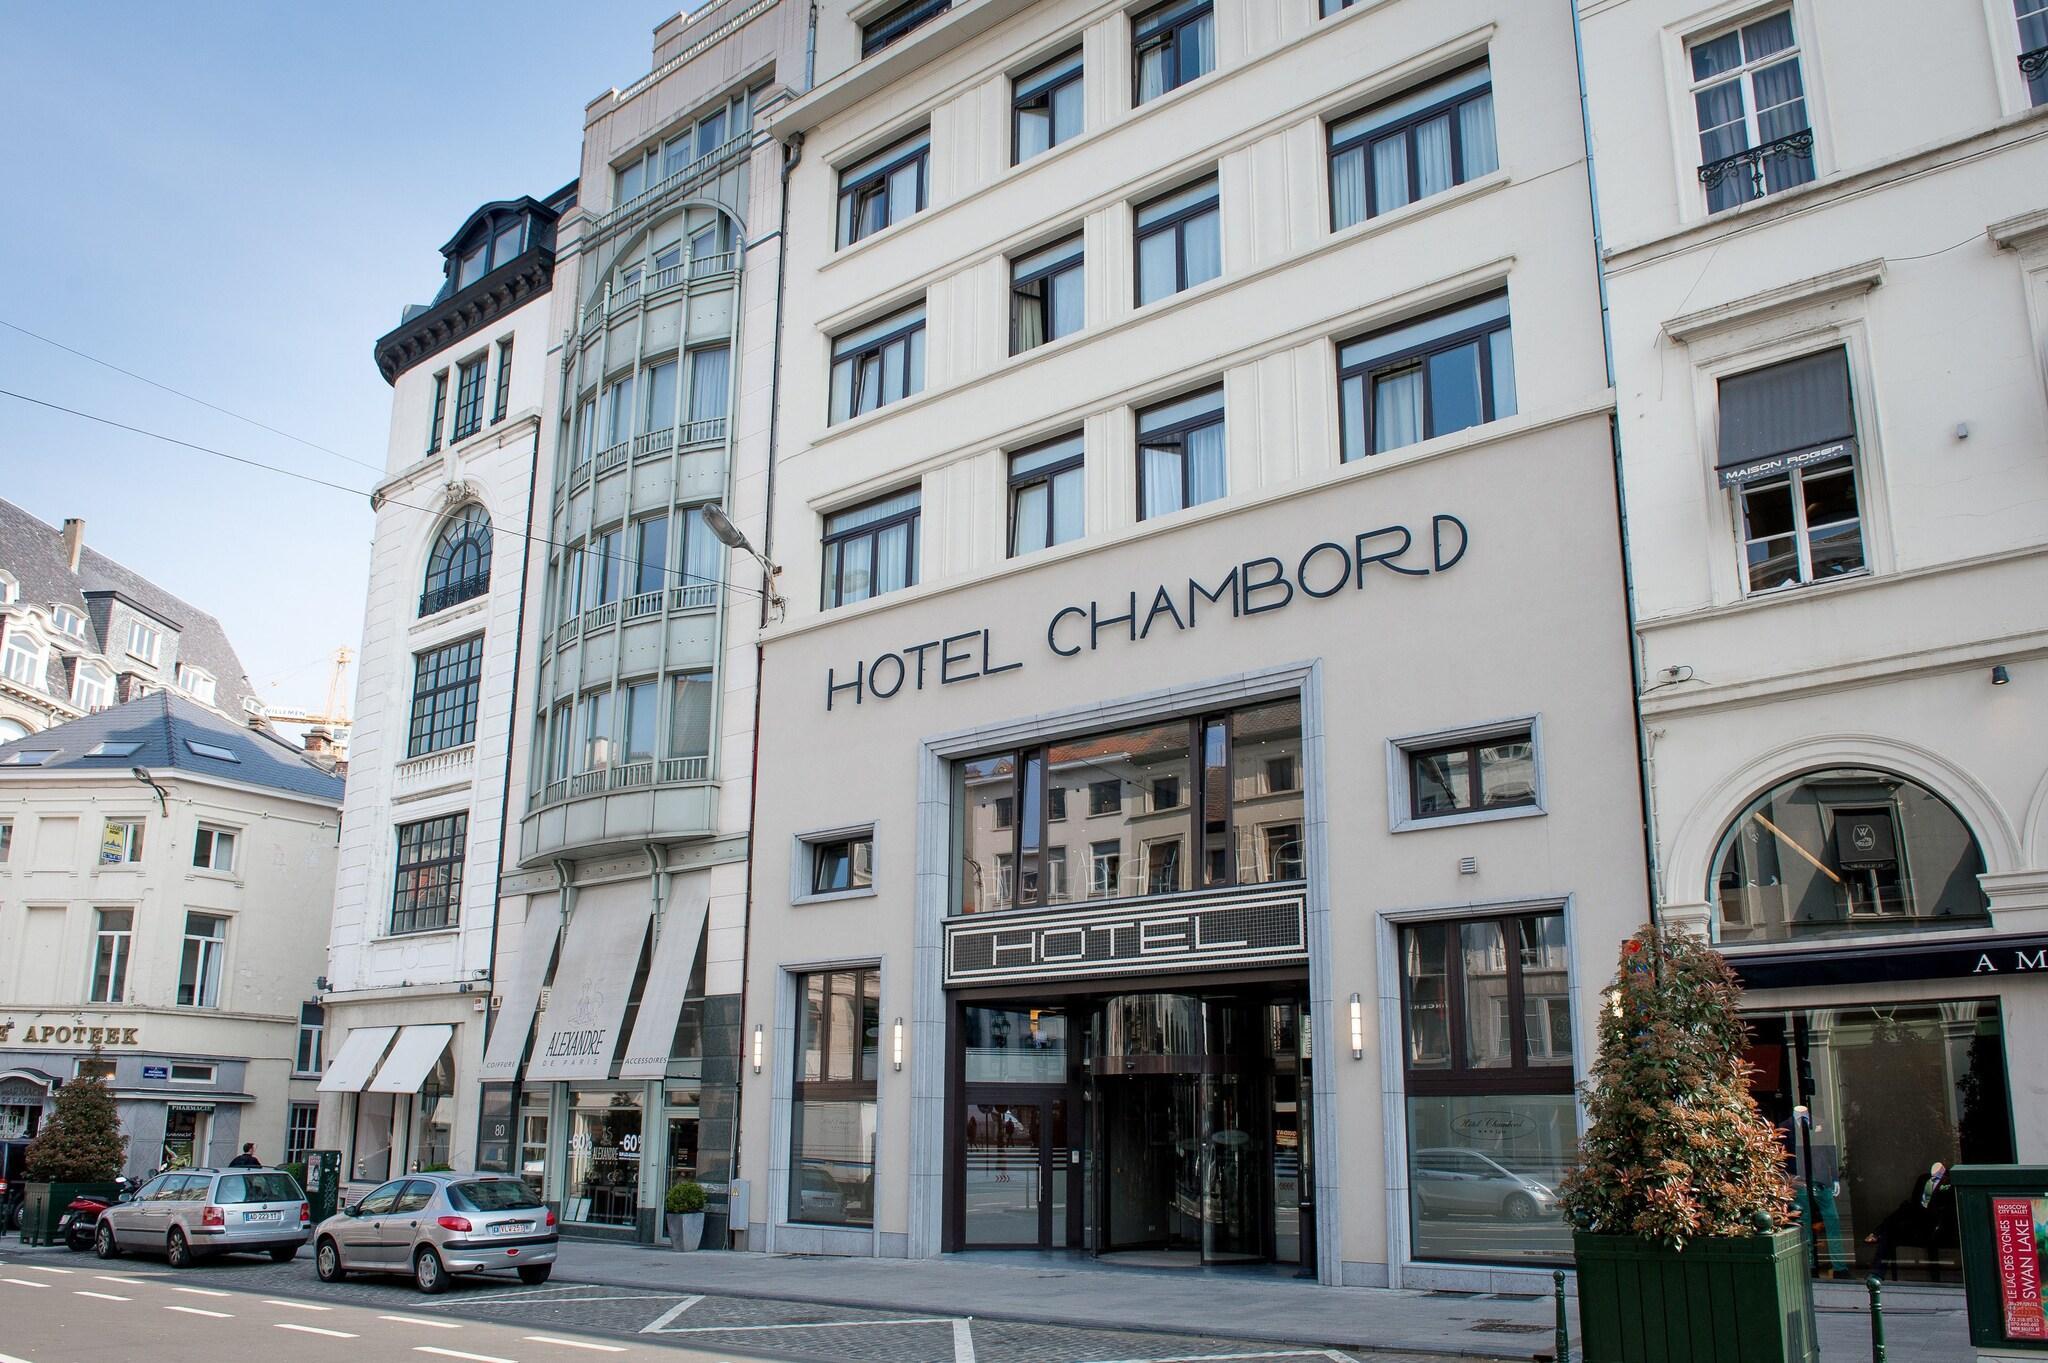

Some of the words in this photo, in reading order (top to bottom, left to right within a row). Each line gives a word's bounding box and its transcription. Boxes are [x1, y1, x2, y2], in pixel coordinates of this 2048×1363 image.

[1726, 460, 1781, 479] MAISON
[1787, 444, 1843, 465] ROGER
[827, 628, 1023, 711] HOTEL
[1047, 514, 1469, 657] CHAMBORD
[992, 915, 1249, 966] HOTEL
[22, 1025, 138, 1044] APOTEEK
[545, 1030, 606, 1056] ALEXANDRE
[486, 1061, 515, 1069] COIFFURE
[625, 1056, 668, 1064] ACCESSOIRES
[495, 1124, 505, 1136] 80
[2000, 1220, 2013, 1254] CYGNES
[2015, 1219, 2032, 1252] LAKE
[2003, 1255, 2015, 1271] DES
[2005, 1272, 2016, 1288] LAC
[2019, 1257, 2037, 1299] SWAN
[2007, 1290, 2018, 1299] LE
